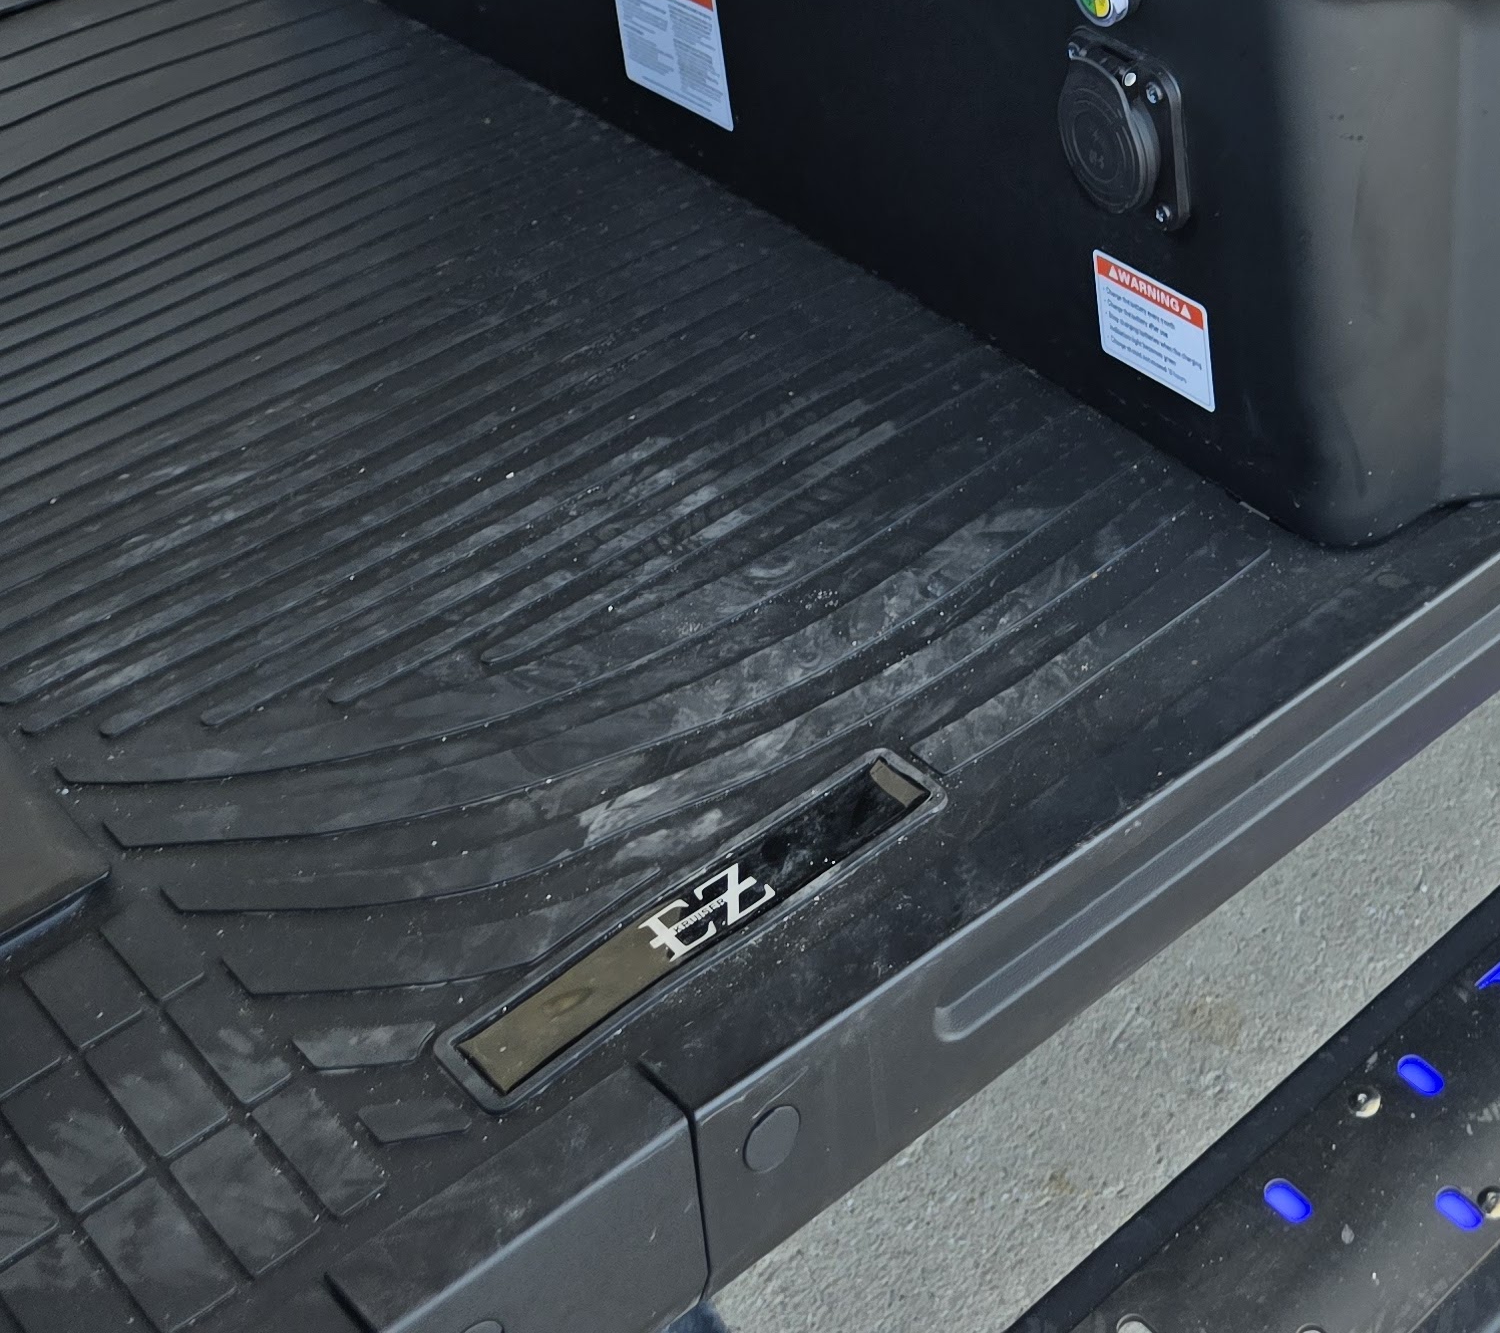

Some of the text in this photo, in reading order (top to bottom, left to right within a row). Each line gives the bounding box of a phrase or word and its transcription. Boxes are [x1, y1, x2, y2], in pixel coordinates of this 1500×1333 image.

[1117, 267, 1180, 313] WARNING
[638, 863, 776, 963] EZ
[673, 898, 724, 934] KRUISER
